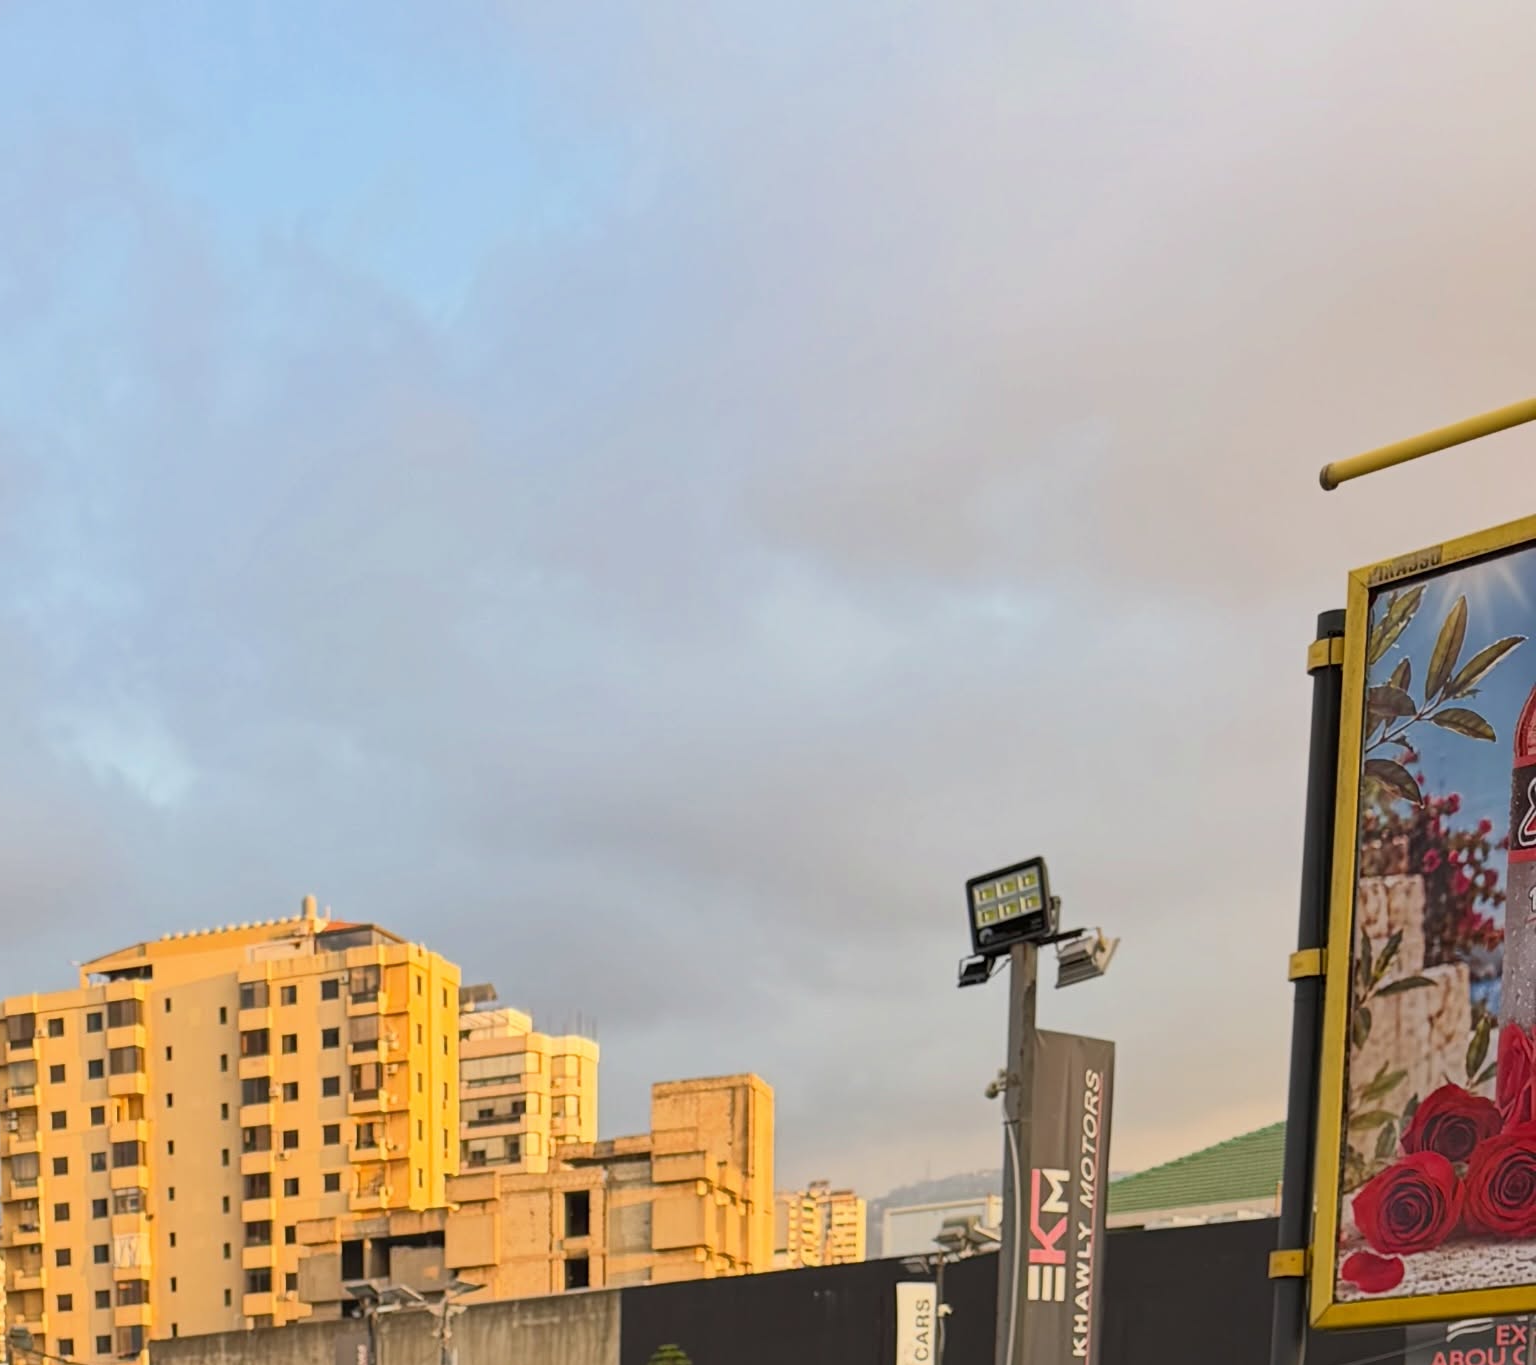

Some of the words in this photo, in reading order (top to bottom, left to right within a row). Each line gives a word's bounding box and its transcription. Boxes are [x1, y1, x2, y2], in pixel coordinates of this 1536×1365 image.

[1079, 1068, 1101, 1209] MOTORS
[1027, 1168, 1071, 1302] EKM
[1073, 1221, 1092, 1357] KHAWLY
[914, 1298, 931, 1362] CARS
